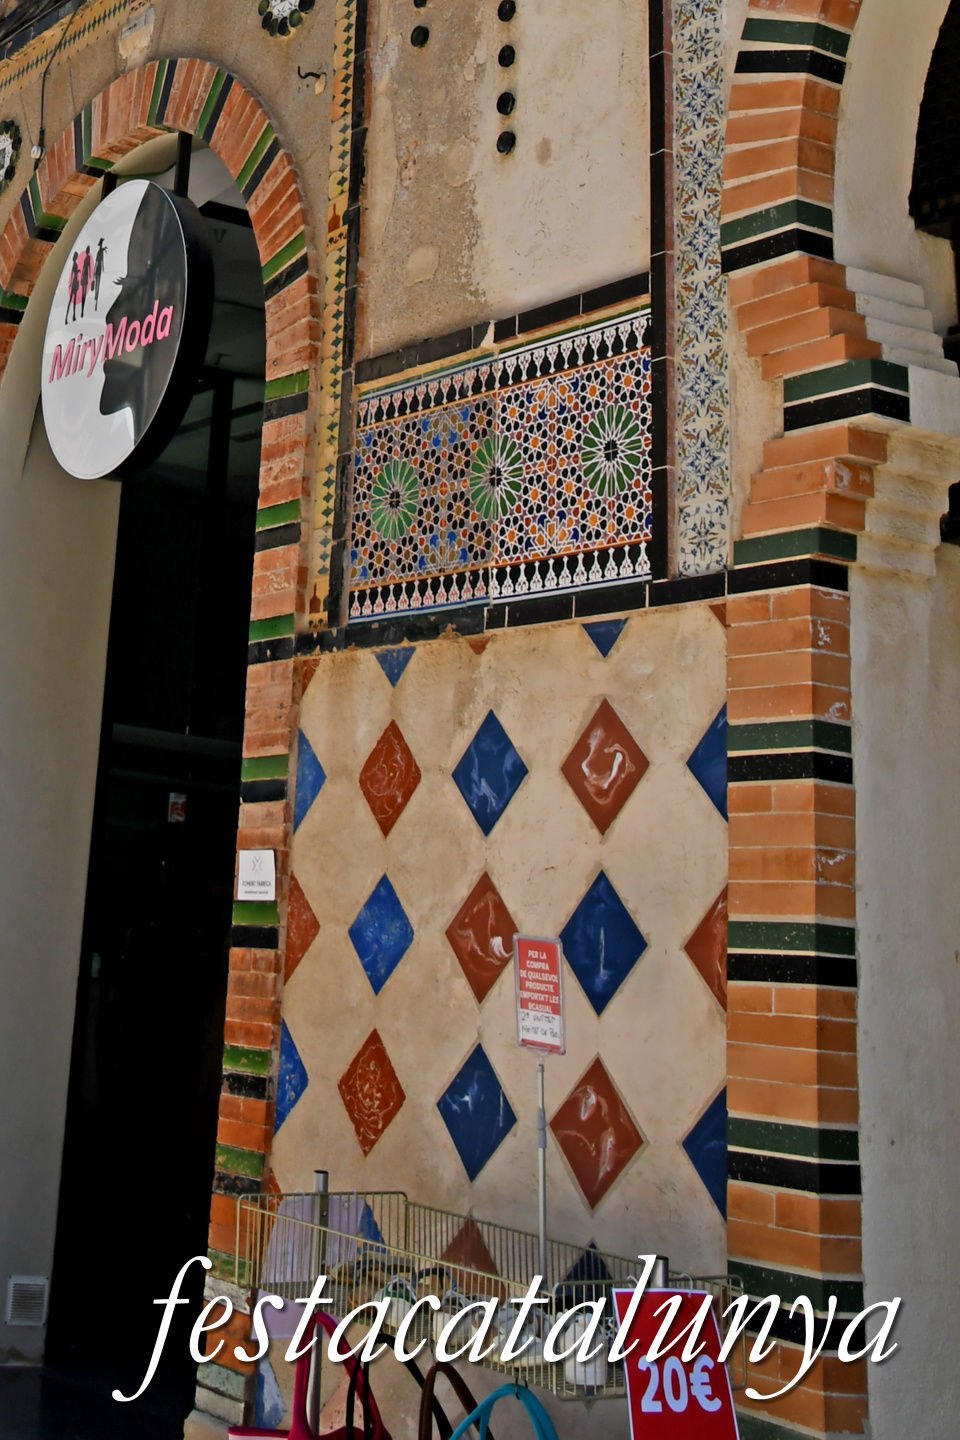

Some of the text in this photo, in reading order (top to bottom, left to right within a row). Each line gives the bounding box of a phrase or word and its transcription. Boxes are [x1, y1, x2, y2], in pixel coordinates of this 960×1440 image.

[48, 298, 174, 384] MiryModa
[528, 949, 547, 960] PER LA
[526, 960, 549, 971] COMPRA
[520, 970, 558, 983] DE QUALSEVOL
[525, 981, 554, 993] PRODUCTE
[549, 994, 559, 1004] LES
[638, 1354, 722, 1413] 20€
